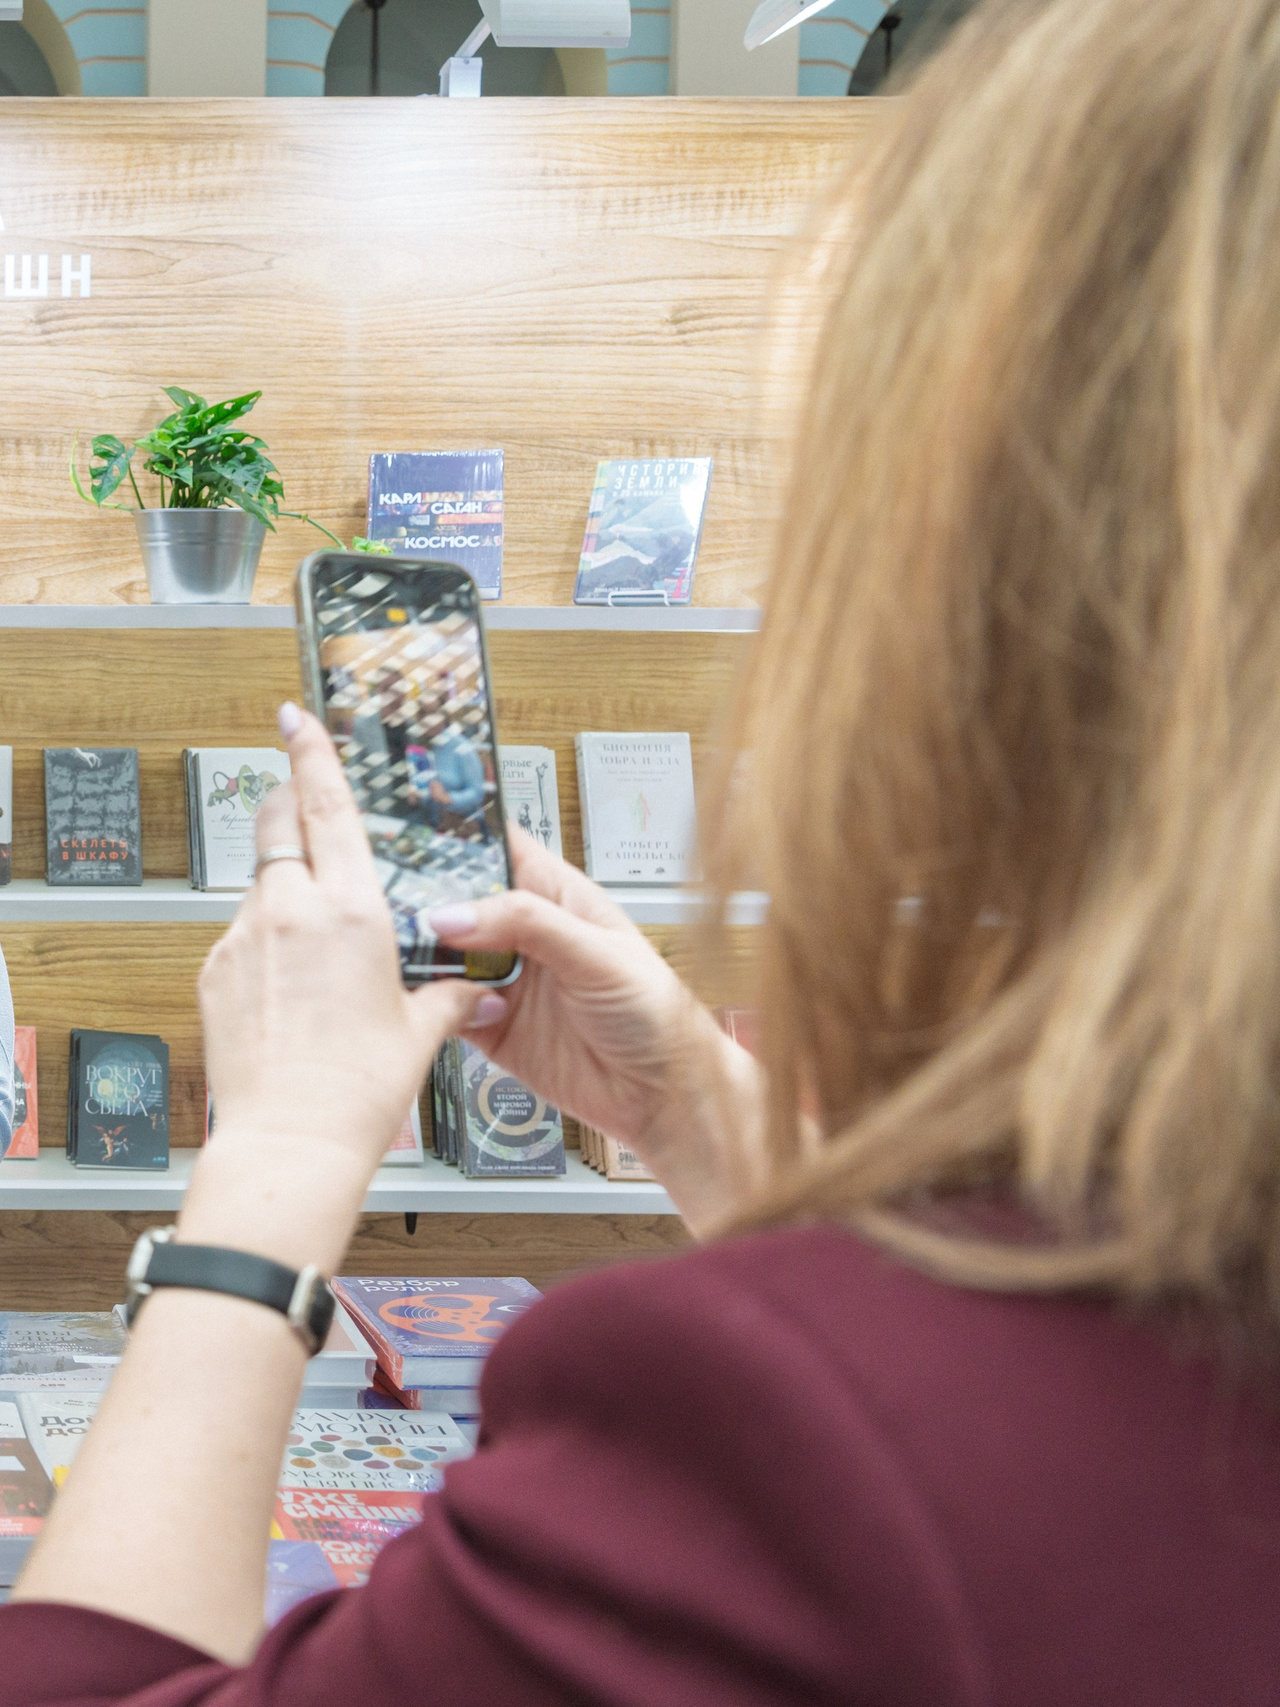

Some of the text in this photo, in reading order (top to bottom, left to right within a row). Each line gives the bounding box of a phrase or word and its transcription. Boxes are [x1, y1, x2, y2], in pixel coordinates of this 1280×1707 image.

[379, 491, 422, 505] КАРЛ
[430, 500, 483, 514] САГАН
[404, 534, 481, 549] КОСМОС
[602, 743, 672, 753] БИОЛОГИЯ
[620, 841, 669, 849] РОБЕРТ
[62, 851, 129, 861] В ШКАФУ
[86, 1064, 163, 1087] ВОКРУГ
[496, 1092, 528, 1101] ВТОРОЙ
[84, 1098, 149, 1117] СВЕТА
[493, 1100, 532, 1109] МИРОВОЙ
[498, 1107, 528, 1116] ВОЙНЫ
[356, 1278, 460, 1289] Разбор
[363, 1284, 434, 1293] роли
[282, 1502, 424, 1523] СМЕШН
